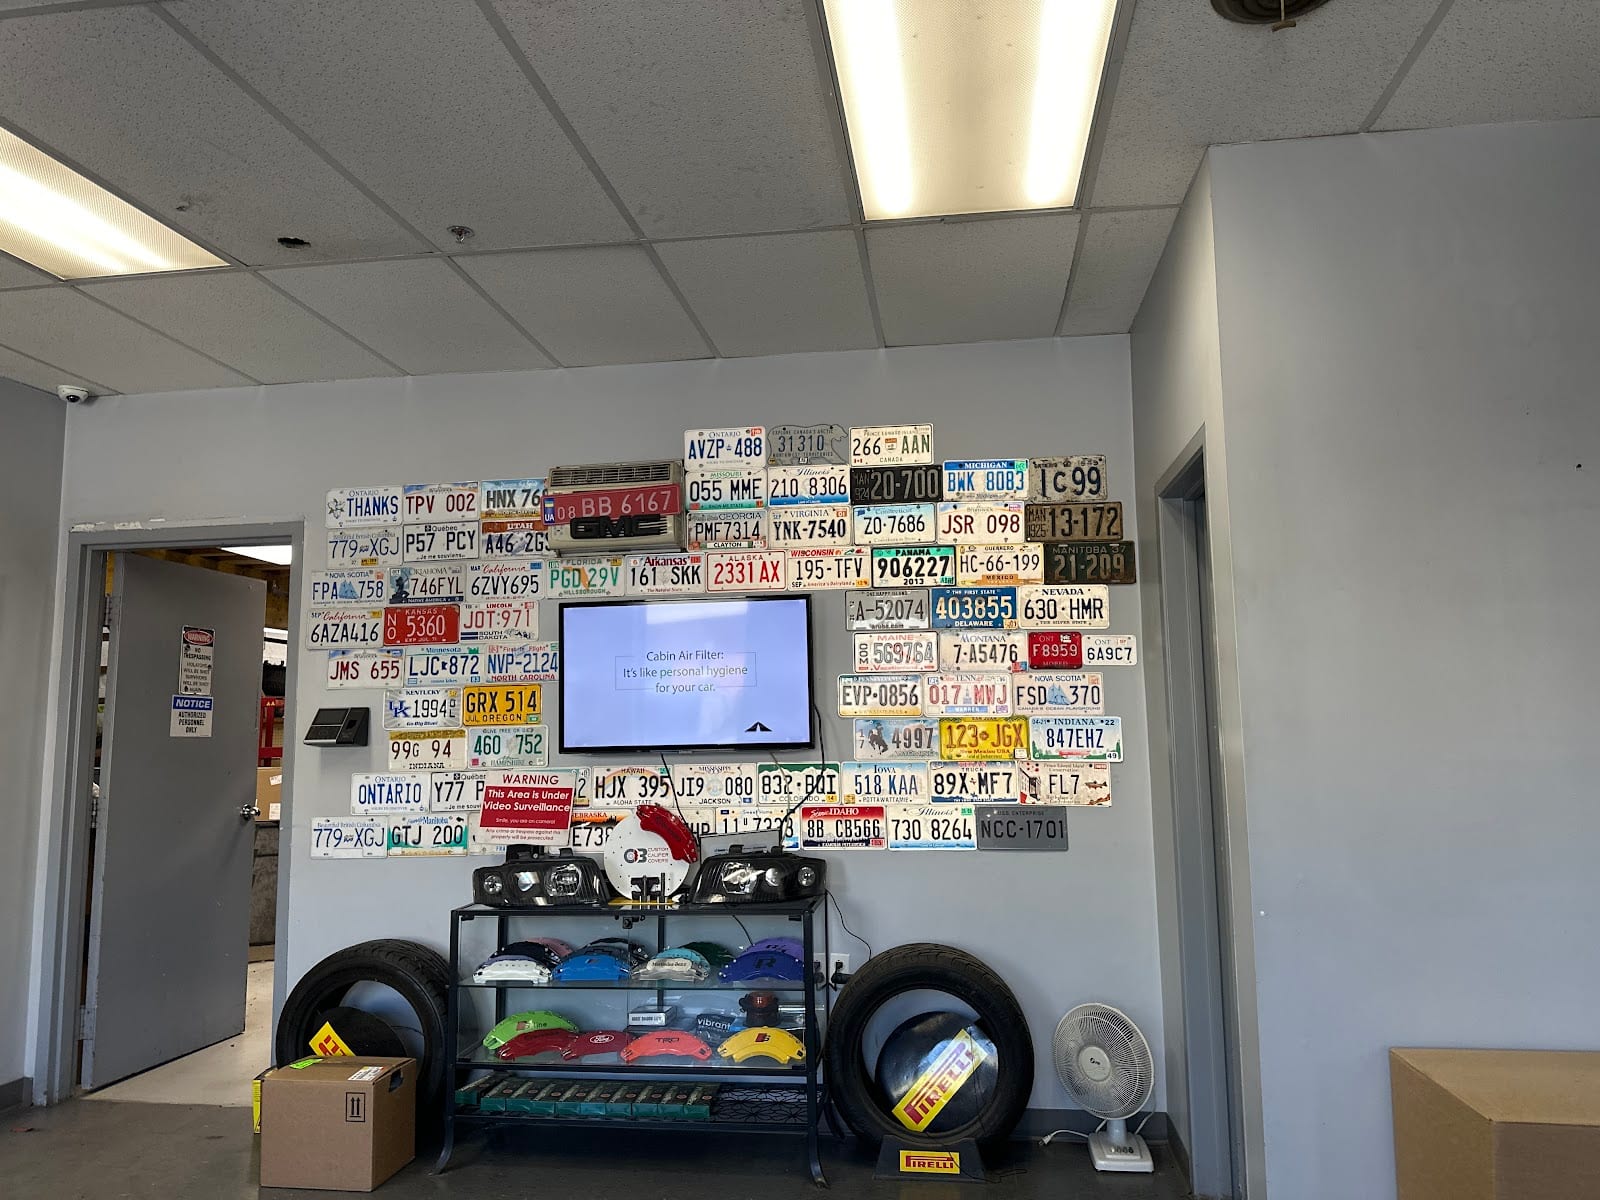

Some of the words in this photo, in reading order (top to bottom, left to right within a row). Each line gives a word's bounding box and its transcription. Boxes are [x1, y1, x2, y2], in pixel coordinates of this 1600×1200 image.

[709, 430, 741, 438] ONTARIO
[734, 437, 763, 458] 488
[852, 437, 882, 457] 266
[901, 434, 930, 455] AAN
[964, 461, 1008, 470] MICHIGAN
[730, 478, 763, 501] MME
[770, 479, 799, 498] 210
[809, 476, 847, 496] 8306
[870, 468, 940, 500] 20-700
[947, 471, 975, 492] BWK
[985, 470, 1025, 492] 8083
[346, 495, 399, 518] THANKS
[405, 494, 435, 515] TPV
[486, 488, 517, 509] HNX
[581, 496, 613, 518] BB
[620, 490, 672, 515] 6167
[544, 513, 555, 522] UA
[718, 512, 762, 521] GEORGIA
[789, 509, 830, 518] VIRGINIA
[1049, 507, 1119, 537] 13-172
[506, 522, 534, 530] UTAH
[569, 513, 669, 540] GMC
[695, 521, 760, 542] PMF7314
[942, 514, 974, 535] JSR
[328, 540, 359, 559] 779
[369, 537, 400, 557] XGJ
[405, 533, 436, 553] P57
[446, 530, 476, 551] PCY
[485, 533, 514, 554] A46
[713, 541, 742, 549] CLAYTON
[1052, 545, 1107, 555] MANITOBA
[643, 556, 688, 567] Arkansas
[728, 554, 764, 562] ALASKA
[790, 548, 835, 557] WISCONSIN
[895, 549, 932, 557] PANAMA
[713, 562, 755, 586] 2331
[759, 560, 780, 583] AX
[877, 555, 950, 579] 906227
[959, 553, 1041, 574] HC-66-199
[1054, 553, 1126, 582] 21-209
[410, 576, 464, 596] 746FYL
[471, 574, 540, 596] 6ZVY695
[588, 566, 619, 588] 29V
[630, 567, 657, 587] 161
[670, 565, 702, 586] SKK
[903, 577, 925, 585] 2013
[311, 581, 338, 601] FPA
[358, 580, 384, 599] 758
[1041, 588, 1084, 596] NEVADA
[311, 611, 322, 619] SEP
[405, 607, 438, 615] KANSAS
[935, 596, 1013, 620] 403855
[1069, 598, 1104, 620] HMR
[310, 622, 380, 644] 6AZA416
[406, 614, 446, 637] 5360
[954, 620, 994, 628] DELAWARE
[877, 634, 914, 642] MAINE
[960, 633, 1007, 643] MONTANA
[425, 646, 462, 654] Minnesota
[646, 651, 676, 662] Cabin
[678, 650, 693, 661] Air
[695, 649, 725, 661] Filter:
[1032, 643, 1078, 658] F8959
[1087, 646, 1132, 661] 6A9C7
[329, 660, 360, 681] JMS
[370, 660, 400, 680] 655
[408, 656, 440, 677] LJC
[449, 655, 480, 675] 872
[487, 651, 559, 675] NVP-2124
[623, 668, 638, 678] It's
[639, 667, 658, 678] like
[659, 665, 704, 680] personal
[706, 664, 748, 679] hygiene
[491, 674, 517, 682] NORTH
[519, 673, 556, 682] CAROLINA
[1055, 674, 1082, 682] SCOTIA
[655, 682, 670, 693] for
[671, 682, 696, 695] your
[697, 682, 716, 693] car.
[1016, 686, 1048, 706] FSD
[1069, 685, 1100, 706] 370
[175, 698, 211, 709] NOTICE
[412, 699, 447, 718] 1994
[466, 691, 500, 714] GRX
[505, 689, 537, 713] 514
[178, 711, 207, 719] AUTHORIZED
[178, 718, 205, 726] PERSONNEL
[482, 713, 523, 722] OREGON
[1053, 718, 1096, 726] INDIANA
[185, 726, 198, 734] ONLY
[891, 727, 935, 750] 4997
[990, 723, 1025, 748] JGX
[1046, 728, 1105, 749] 847EHZ
[473, 735, 501, 756] 460
[515, 734, 543, 755] 752
[408, 762, 446, 770] INDIANA
[374, 775, 407, 783] ONTARIO
[503, 774, 559, 785] WARNING
[595, 776, 627, 799] HJX
[638, 775, 670, 798] 395
[854, 775, 883, 796] 518
[888, 774, 919, 796] KAA
[358, 783, 422, 805] ONTARIO
[434, 780, 465, 802] Y77
[488, 789, 505, 799] This
[507, 790, 530, 799] Area
[532, 790, 540, 799] is
[541, 790, 570, 800] Under
[698, 797, 732, 805] JACKSON
[484, 801, 512, 811] Video
[513, 802, 571, 812] Surveillance
[829, 807, 860, 816] IDAHO
[422, 815, 449, 825] Manitoba
[807, 819, 825, 839] 8B
[891, 819, 922, 841] 730
[931, 818, 973, 841] 8264
[980, 820, 1065, 839] NCC-1701
[312, 828, 343, 848] 779
[354, 828, 385, 848] XGJ
[391, 825, 422, 846] GTJ
[432, 825, 464, 845] 200
[697, 1018, 732, 1030] vibrant
[593, 1035, 612, 1043] Ford
[903, 1041, 976, 1126] PIRELLI
[905, 1154, 955, 1169] PIRELLI
